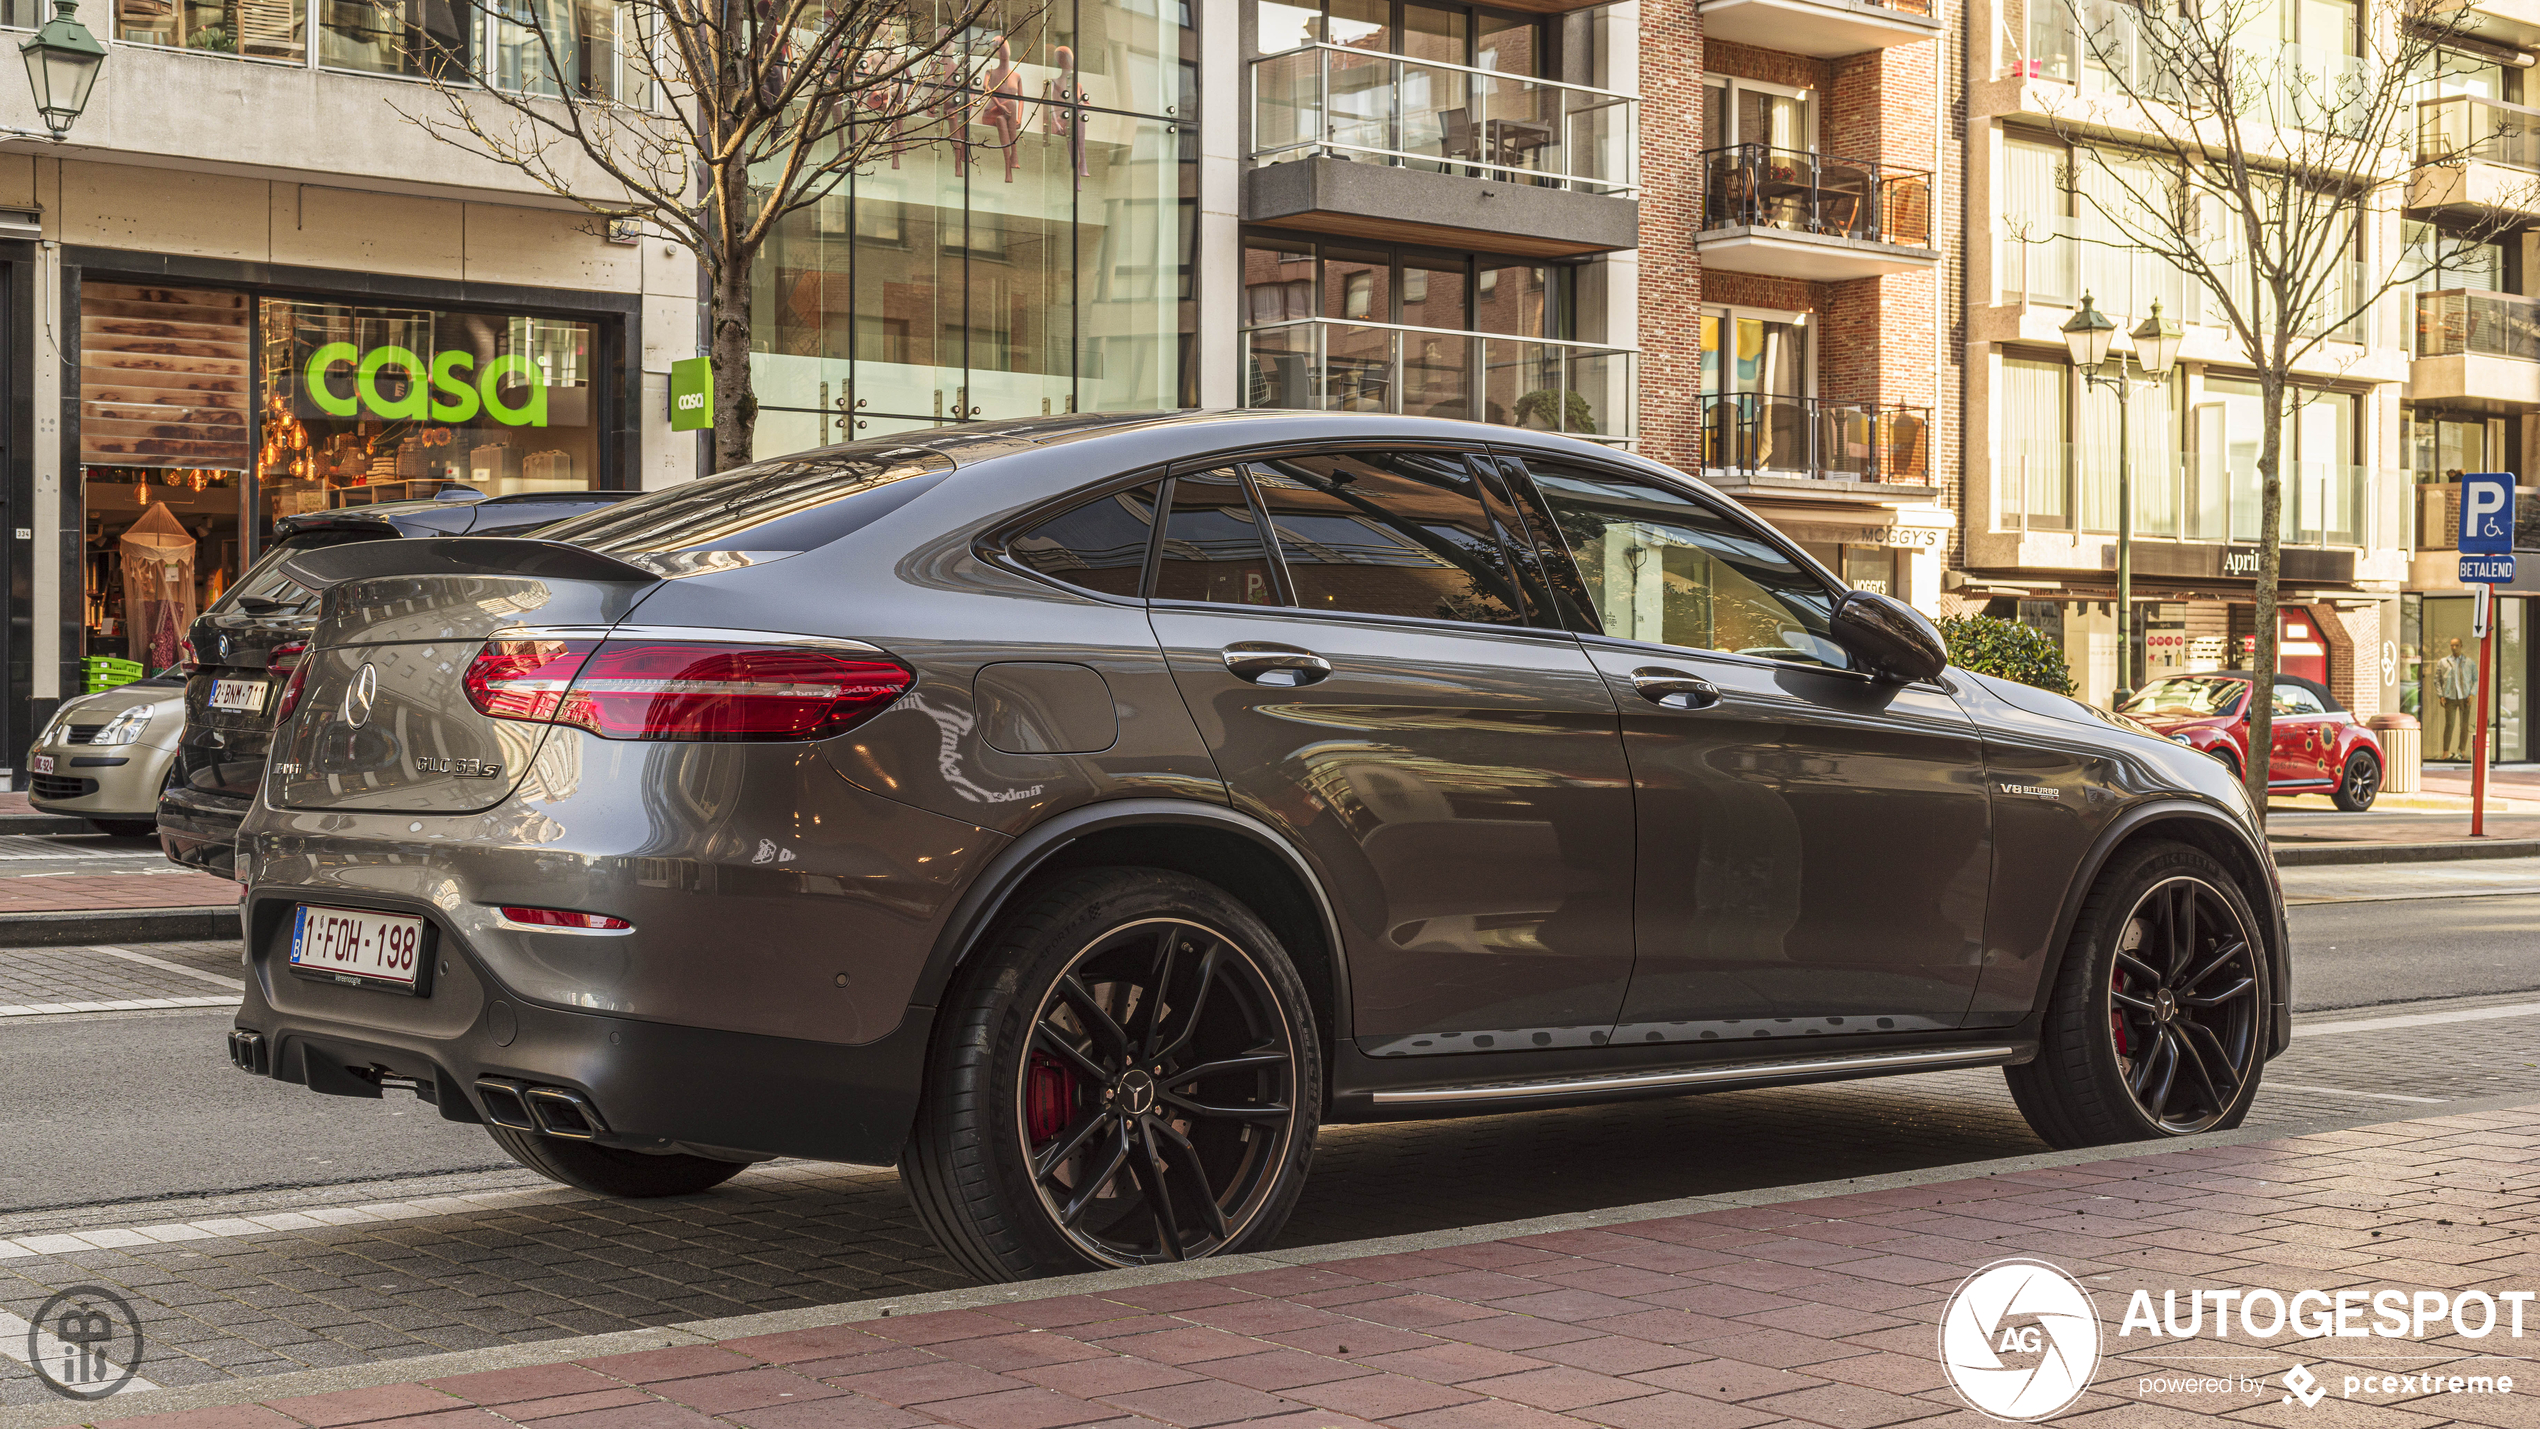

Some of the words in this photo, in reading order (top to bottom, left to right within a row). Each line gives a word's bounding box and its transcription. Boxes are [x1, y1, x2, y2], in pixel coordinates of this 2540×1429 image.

[306, 341, 548, 427] casa
[678, 393, 704, 411] casa
[2466, 481, 2506, 537] P
[1861, 527, 1937, 546] MOGGY'S
[2223, 548, 2260, 576] April
[2459, 562, 2513, 578] BETALEND
[416, 756, 452, 773] GLC
[2000, 783, 2022, 794] V8
[2023, 785, 2059, 795] BITURBO
[293, 938, 301, 958] B
